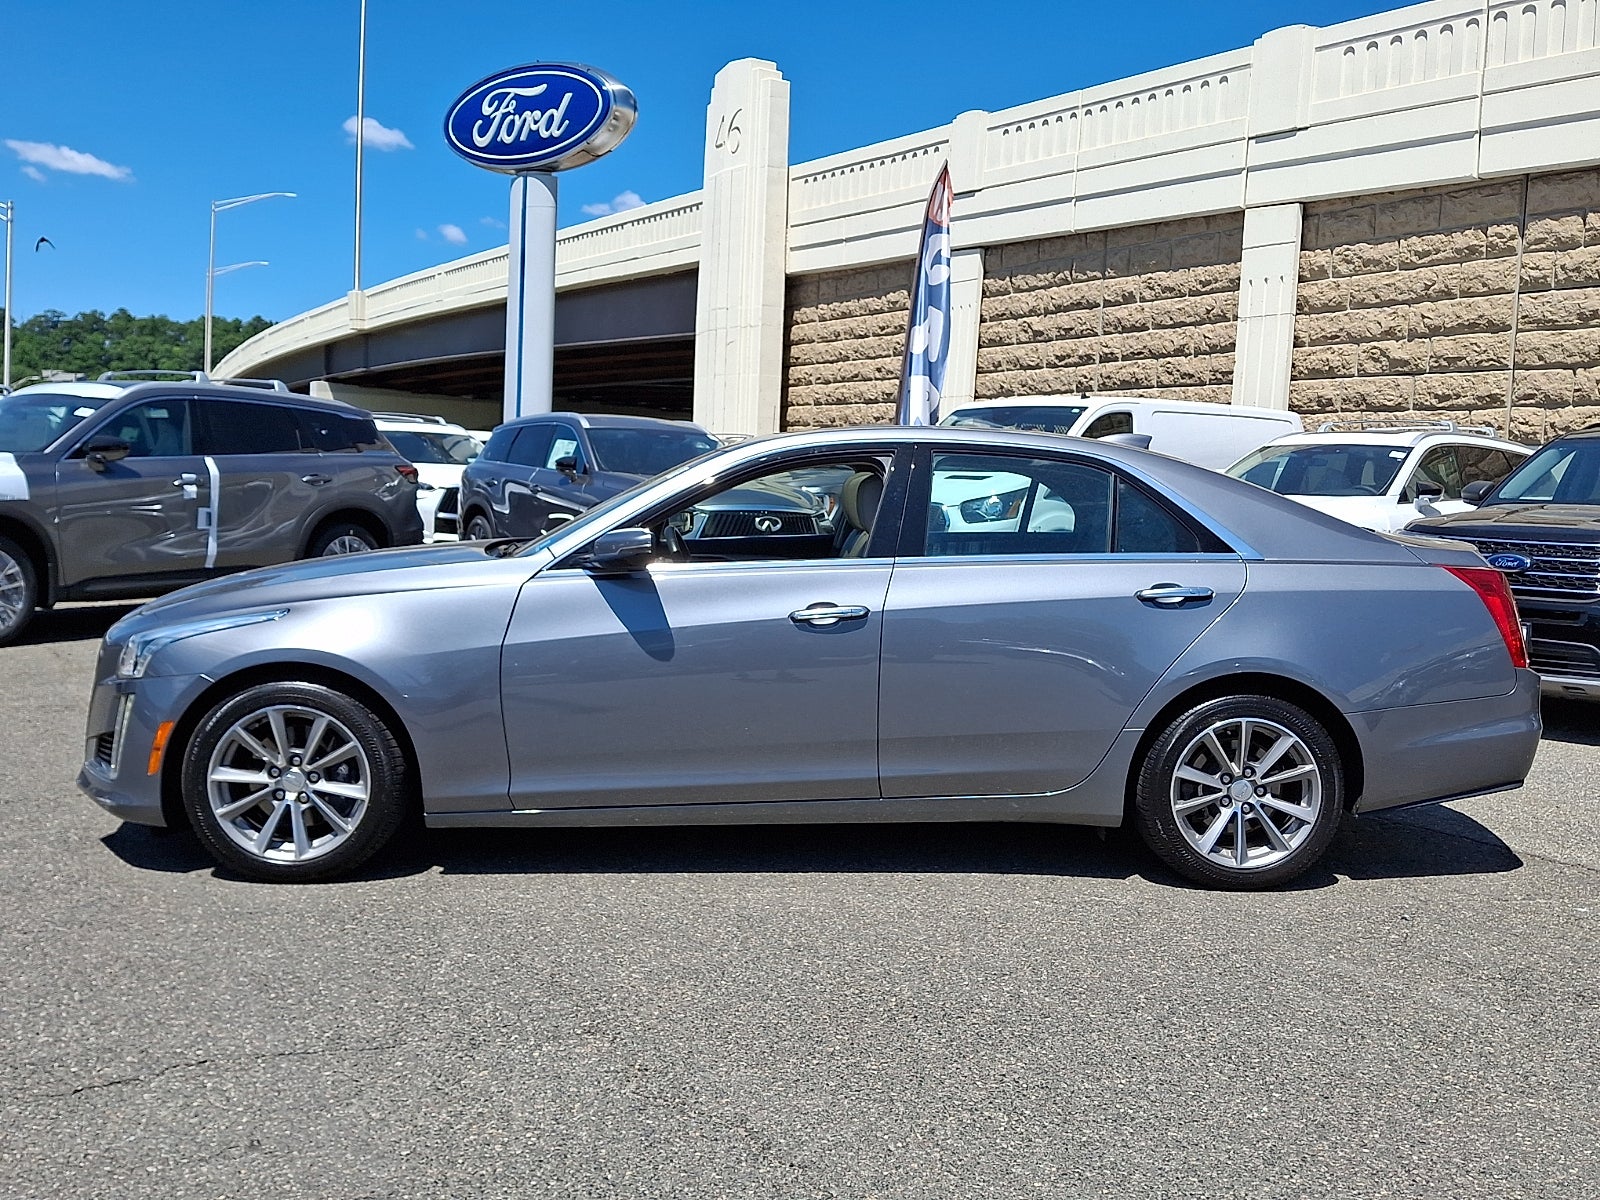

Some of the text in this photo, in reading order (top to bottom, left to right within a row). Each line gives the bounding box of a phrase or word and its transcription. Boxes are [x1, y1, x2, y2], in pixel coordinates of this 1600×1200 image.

[472, 83, 573, 148] Ford
[714, 108, 743, 154] 46
[1495, 556, 1520, 568] Ford
